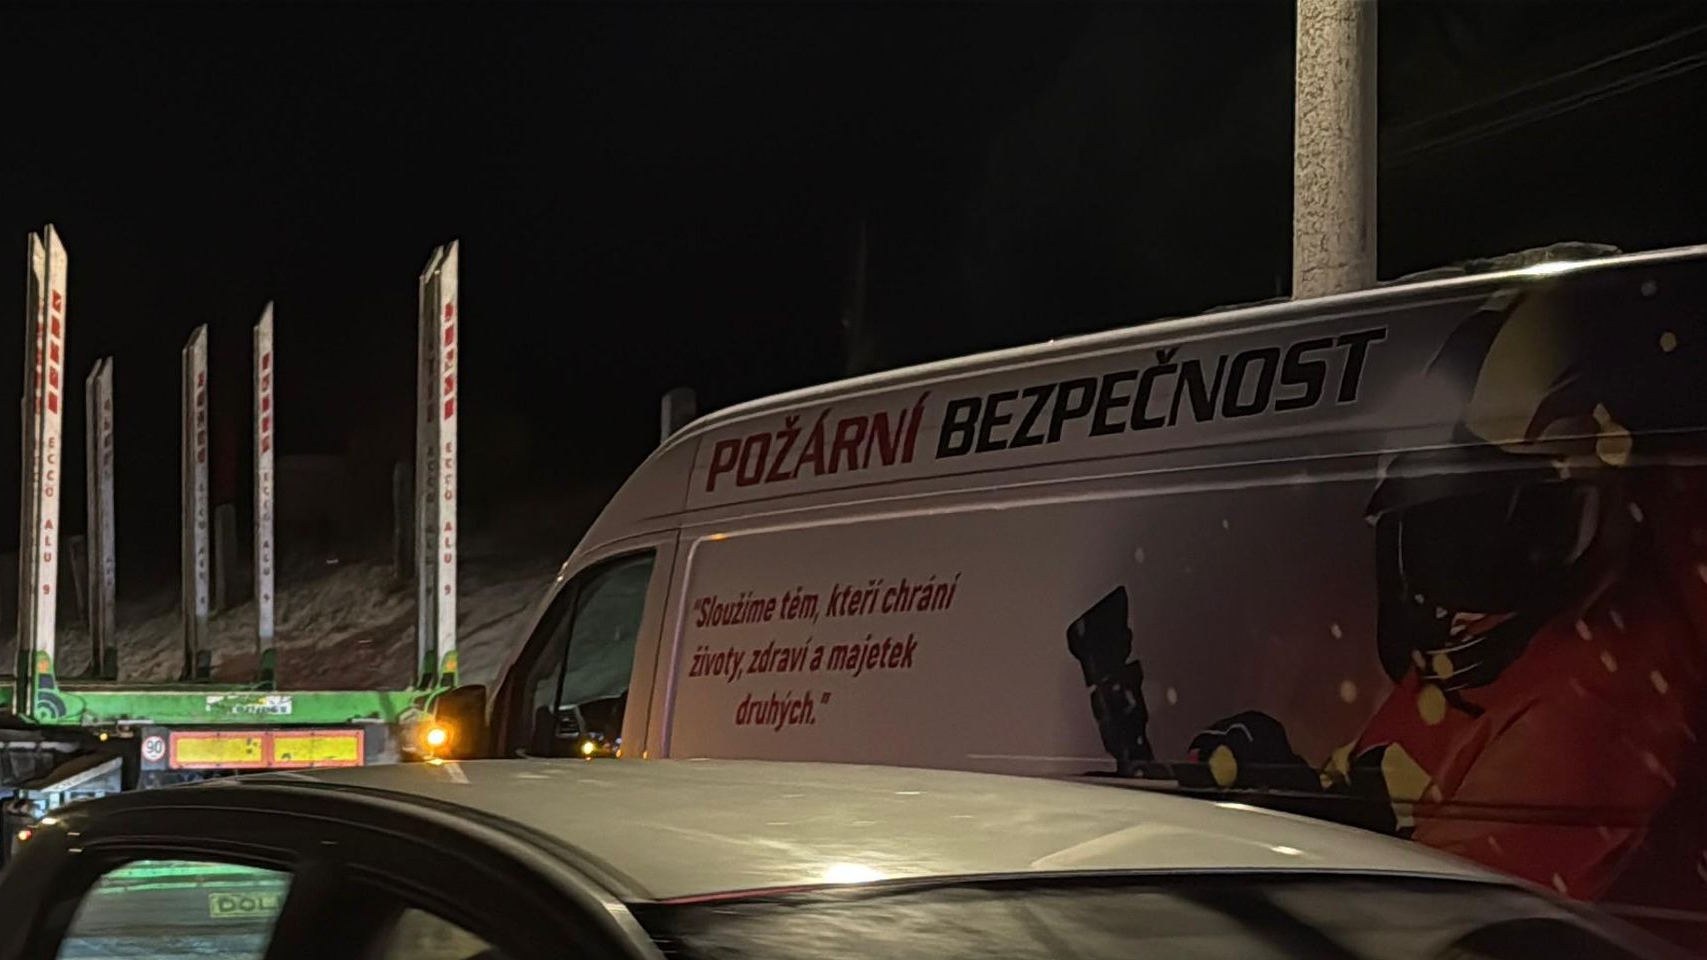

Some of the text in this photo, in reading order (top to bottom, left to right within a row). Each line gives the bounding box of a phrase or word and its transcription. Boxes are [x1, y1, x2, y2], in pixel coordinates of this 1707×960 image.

[705, 326, 1389, 493] POŽÁRNÍ BEZPEČNOST
[44, 436, 56, 498] ECCO
[444, 442, 453, 501] ECCO
[43, 519, 54, 562] ALU
[443, 521, 453, 564] ALU
[694, 590, 777, 629] "Sloužíme
[826, 578, 884, 618] kteří
[882, 572, 962, 615] chrání
[688, 633, 919, 684] životy, zdraví a majetek
[735, 690, 832, 732] druhých."
[146, 740, 163, 754] 90
